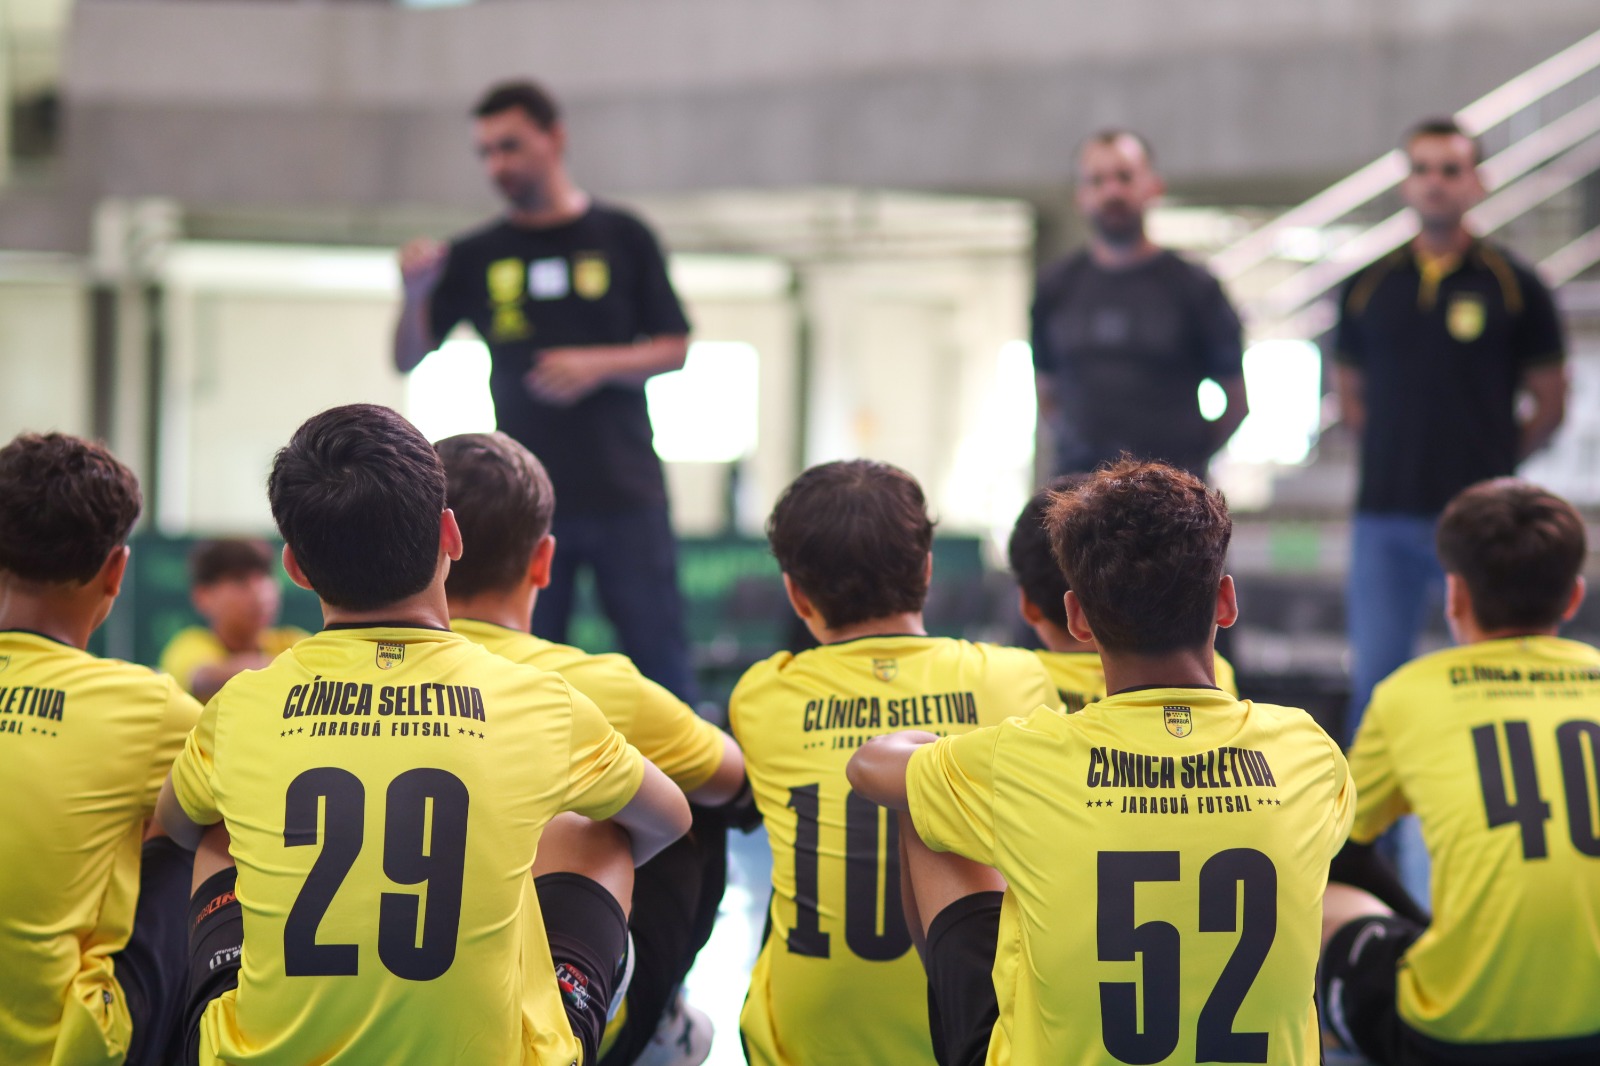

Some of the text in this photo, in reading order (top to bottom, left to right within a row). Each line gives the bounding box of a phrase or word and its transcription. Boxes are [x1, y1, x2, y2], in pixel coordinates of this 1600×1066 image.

[282, 675, 486, 722] CLÍNICA SELETIVA
[803, 692, 978, 732] CLÍNICA SELETIVA
[310, 720, 450, 738] JARAGUÁ FUTSAL
[1180, 747, 1277, 789] SELETIVA
[1471, 719, 1600, 861] 40
[1121, 794, 1252, 814] JARAGUÁ FUTSAL
[282, 766, 470, 982] 29
[786, 782, 914, 962] 10
[1096, 847, 1278, 1065] 52
